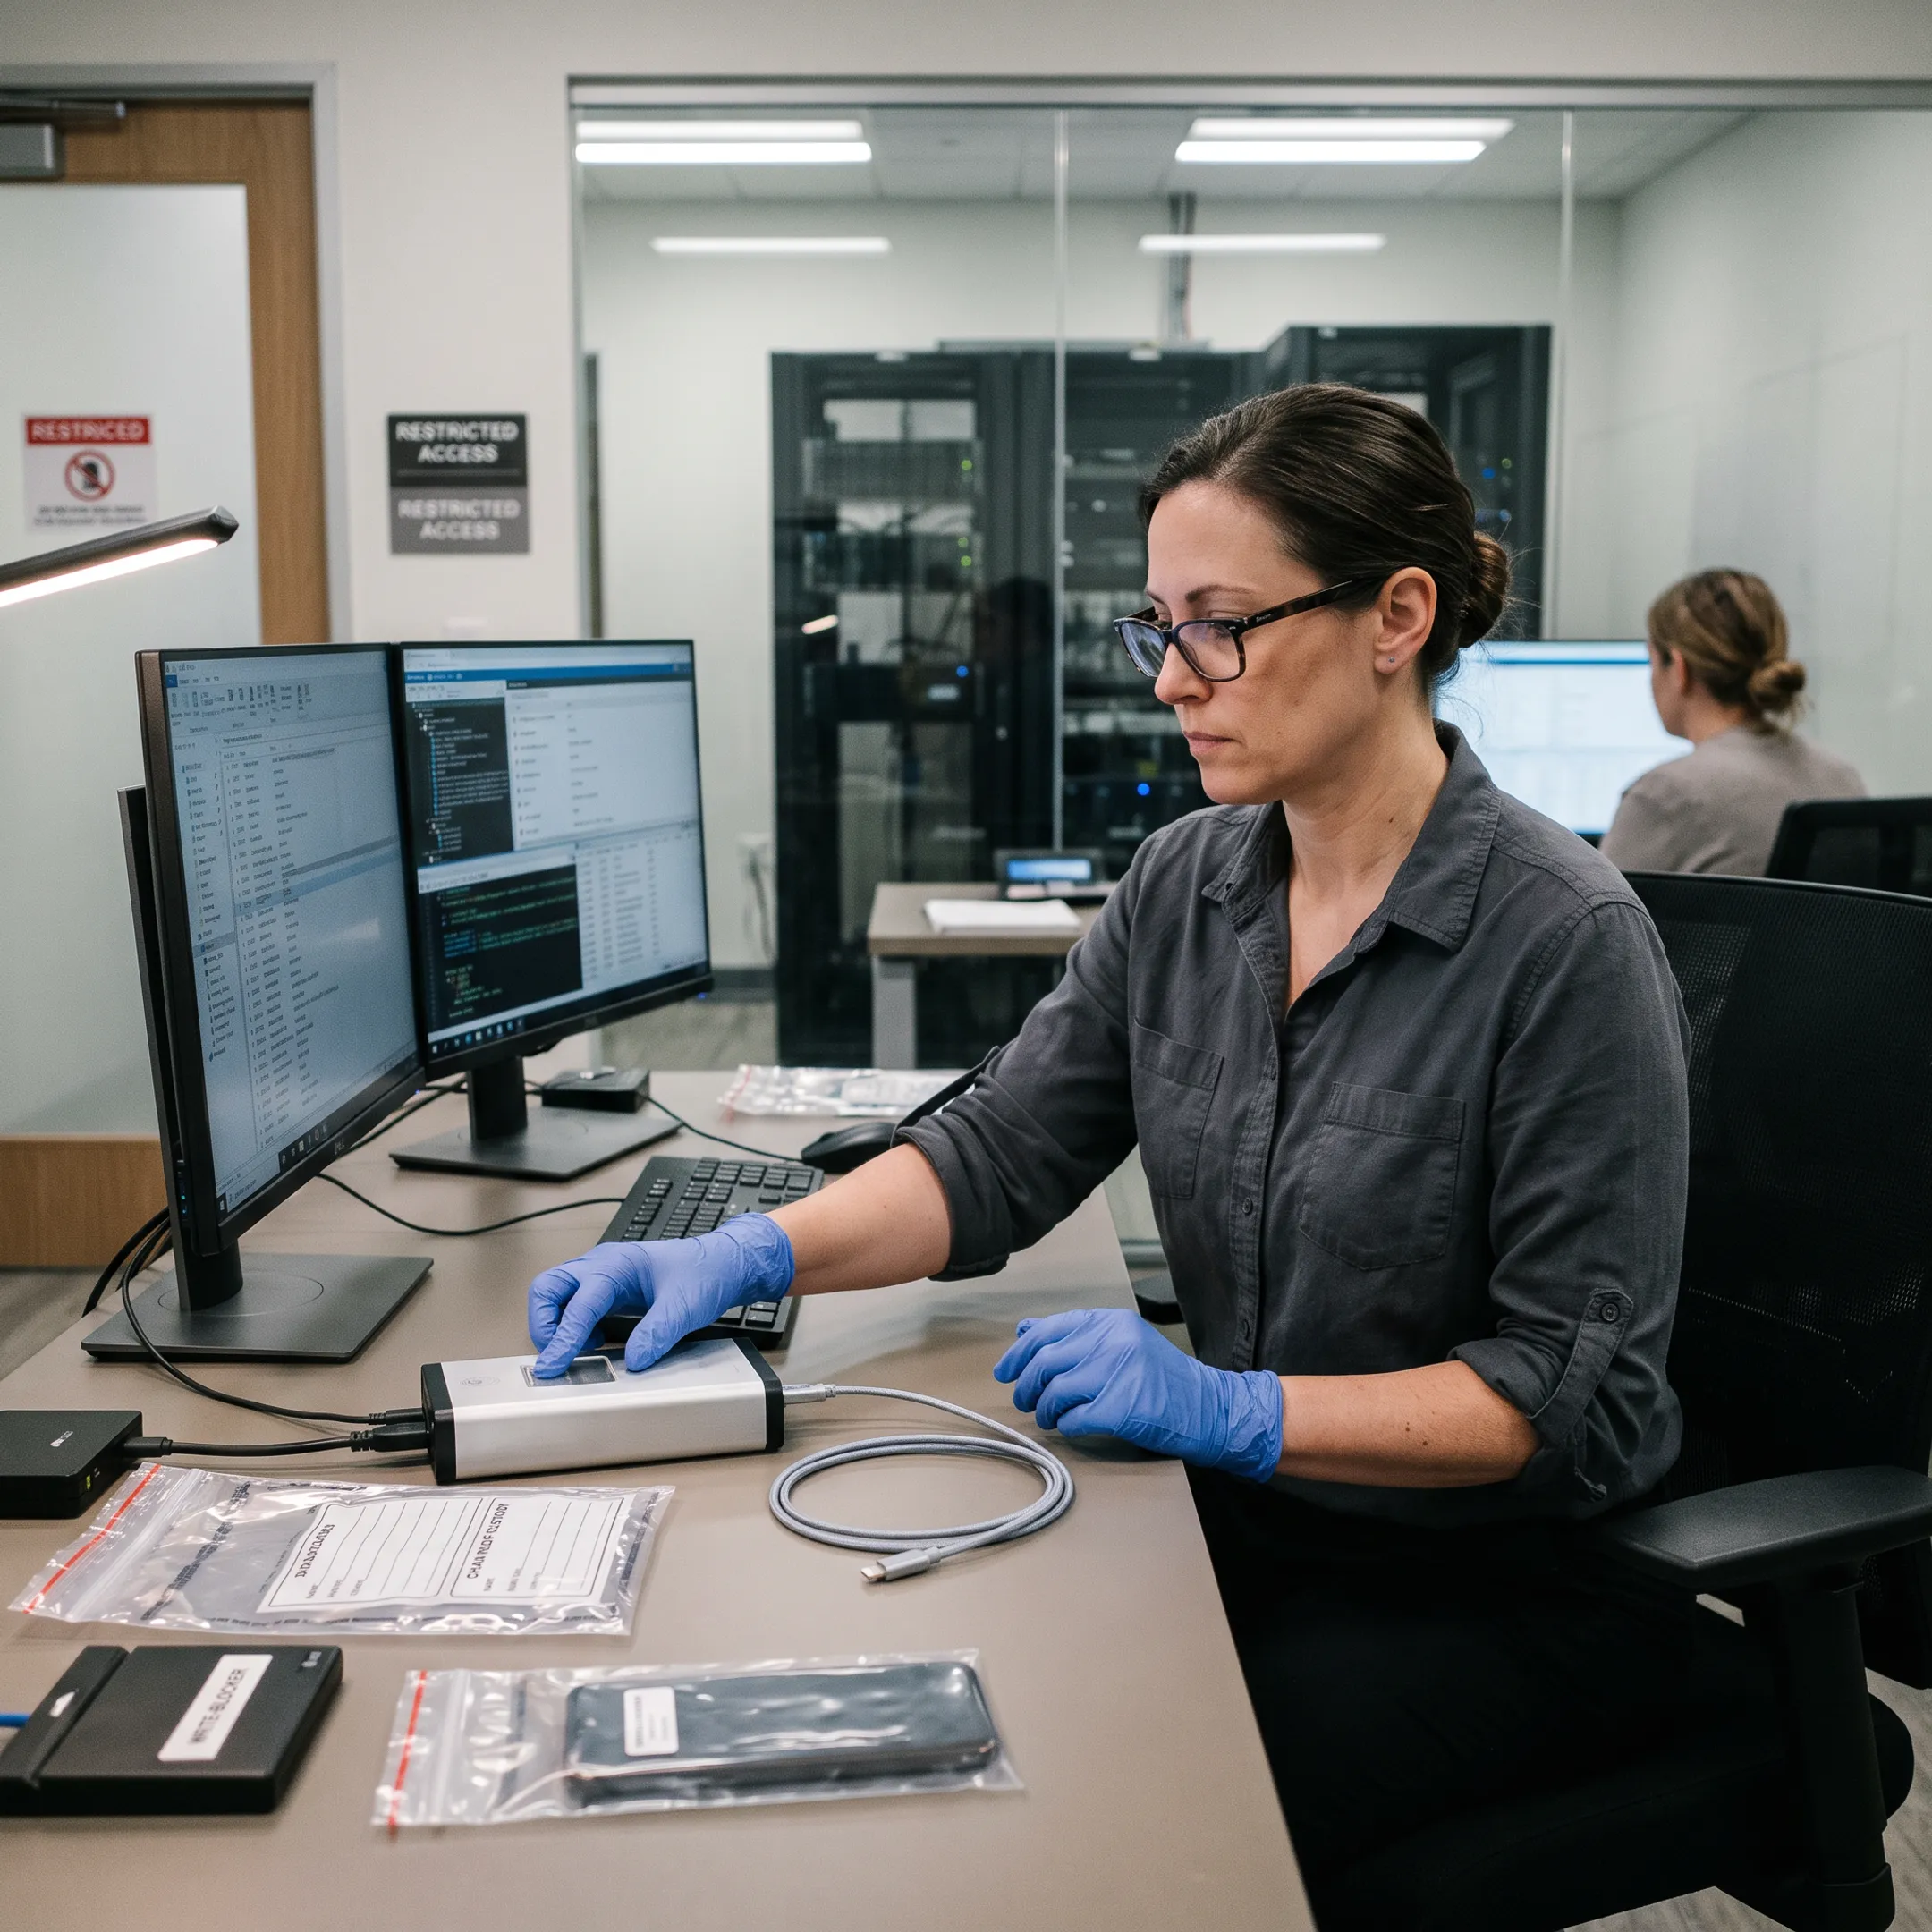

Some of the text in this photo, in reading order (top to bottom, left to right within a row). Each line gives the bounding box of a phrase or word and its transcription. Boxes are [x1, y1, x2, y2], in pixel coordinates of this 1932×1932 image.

[395, 421, 519, 442] RESTRICTED
[417, 443, 499, 463] ACCESS
[398, 498, 521, 519] RESTRICTED
[419, 520, 500, 540] ACCESS
[189, 1667, 250, 1743] WRITE-BLOCKER
